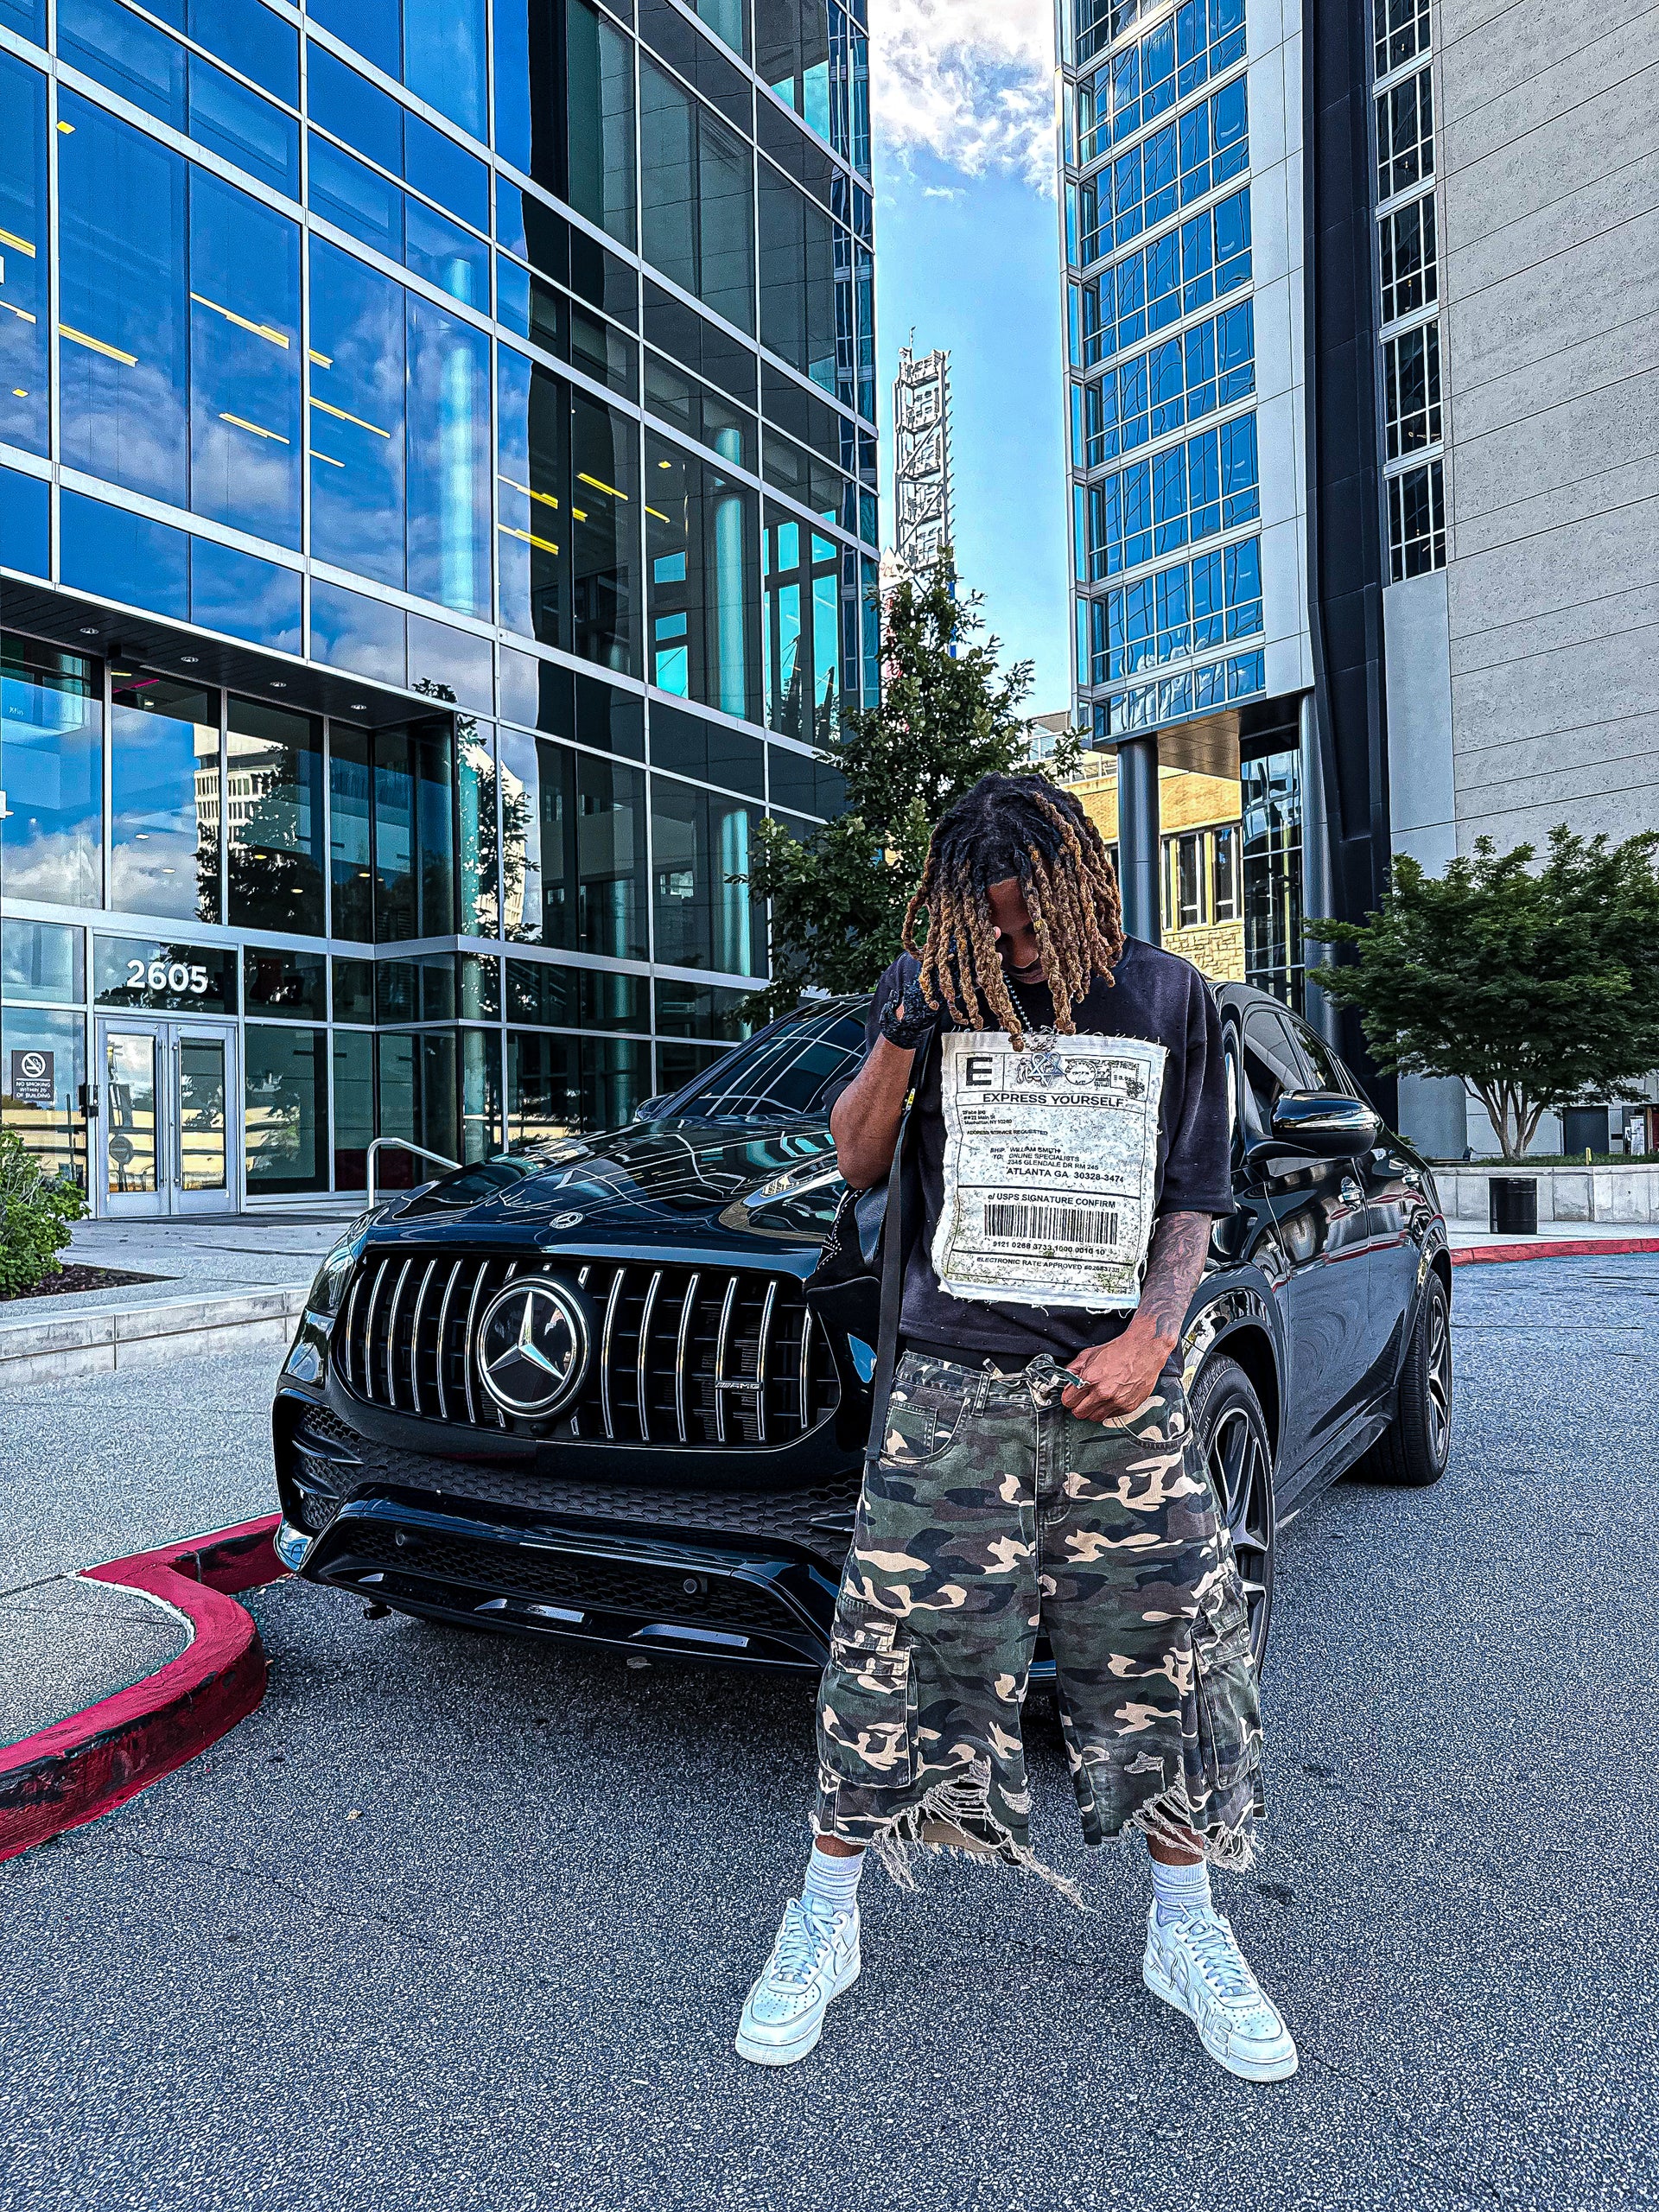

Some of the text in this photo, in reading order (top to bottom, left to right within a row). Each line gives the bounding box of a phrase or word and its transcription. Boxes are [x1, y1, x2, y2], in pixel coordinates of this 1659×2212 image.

[126, 959, 209, 994] 2605
[965, 1056, 994, 1086] E
[982, 1093, 1124, 1107] EXPRESS YOURSELF
[1034, 1154, 1080, 1162] SPECIALISTS
[1006, 1167, 1052, 1178] ATLANTA
[1054, 1170, 1069, 1179] GA
[1021, 1193, 1074, 1205] SIGNATURE
[1075, 1198, 1116, 1208] CONFIRM
[976, 1256, 1020, 1265] ELECTRONIC
[1022, 1258, 1042, 1267] RATE
[1043, 1261, 1083, 1270] APPROVED
